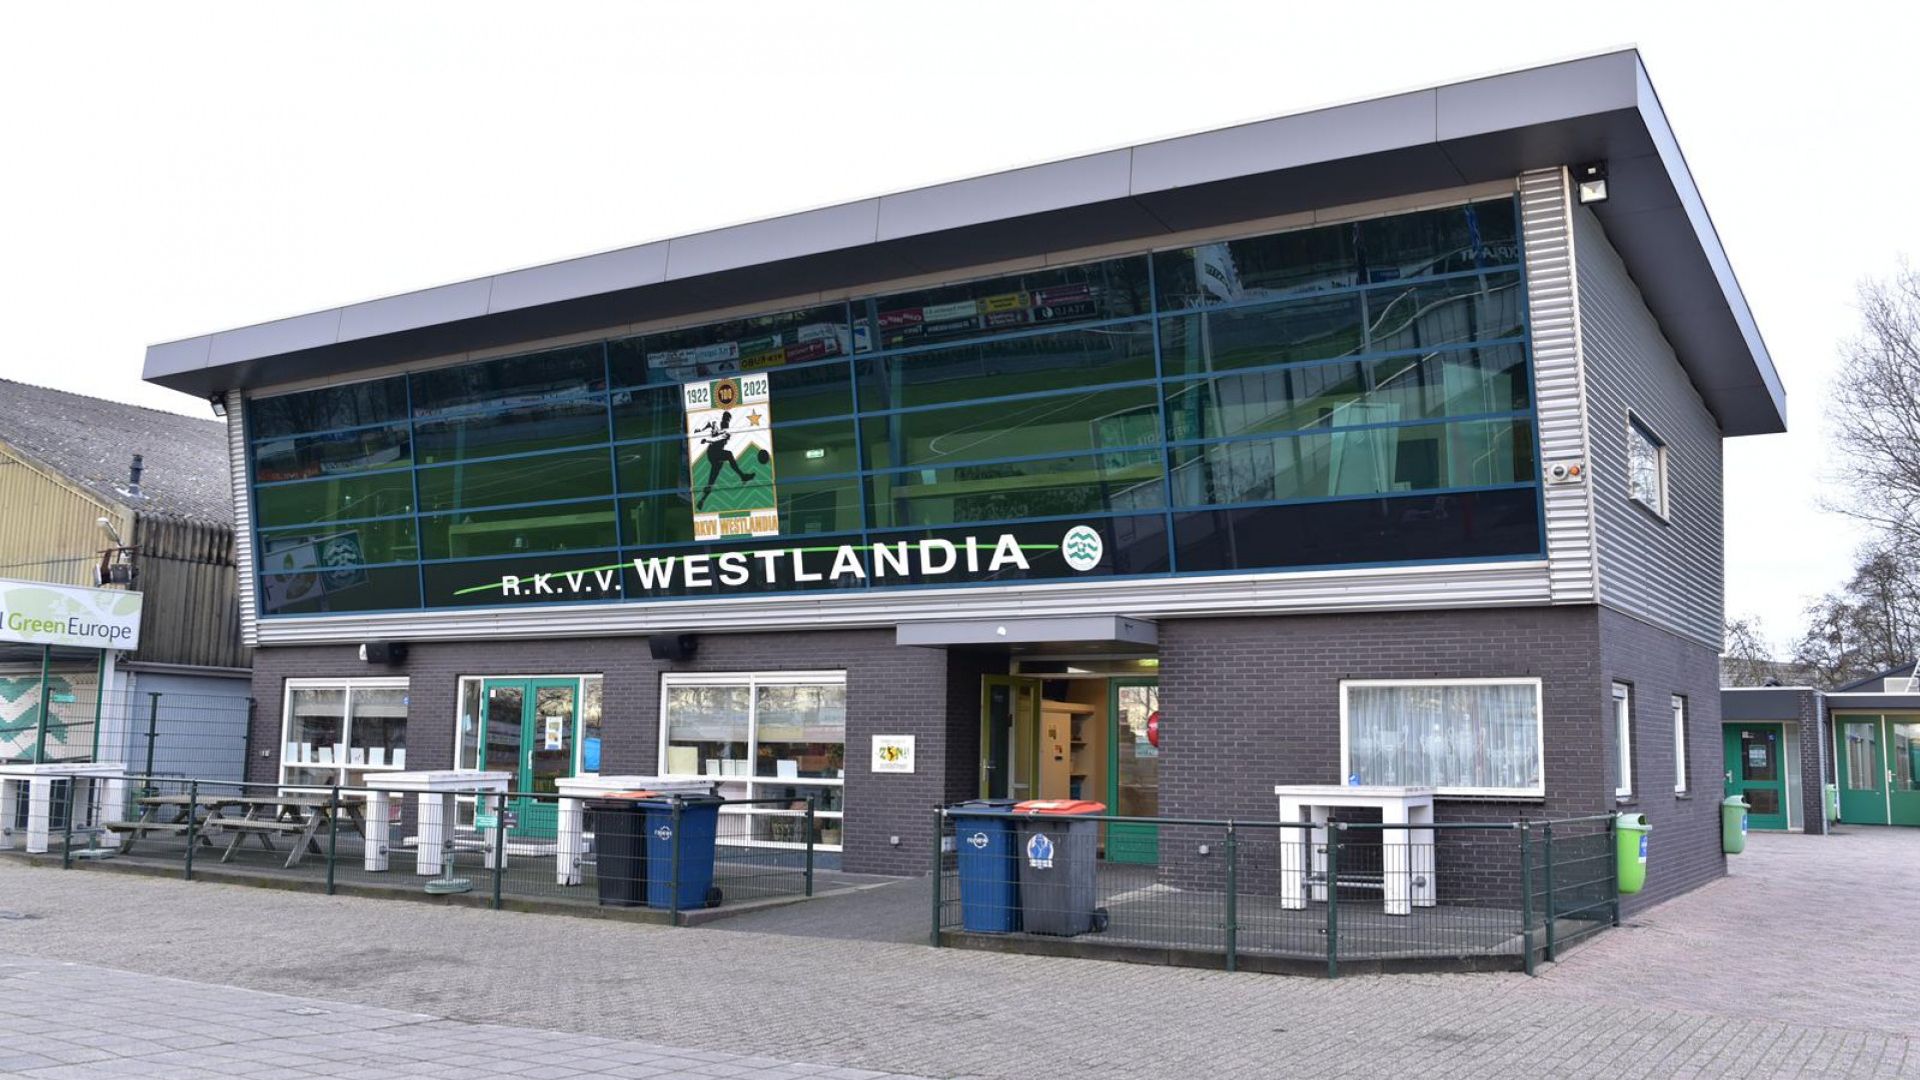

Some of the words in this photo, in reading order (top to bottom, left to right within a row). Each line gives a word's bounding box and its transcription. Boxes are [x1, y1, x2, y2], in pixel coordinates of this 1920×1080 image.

[686, 387, 708, 404] 1922
[743, 379, 767, 397] 2022
[719, 515, 778, 536] WESTLANDIA
[502, 570, 621, 596] R.K.V.V.
[633, 533, 1031, 590] WESTLANDIA
